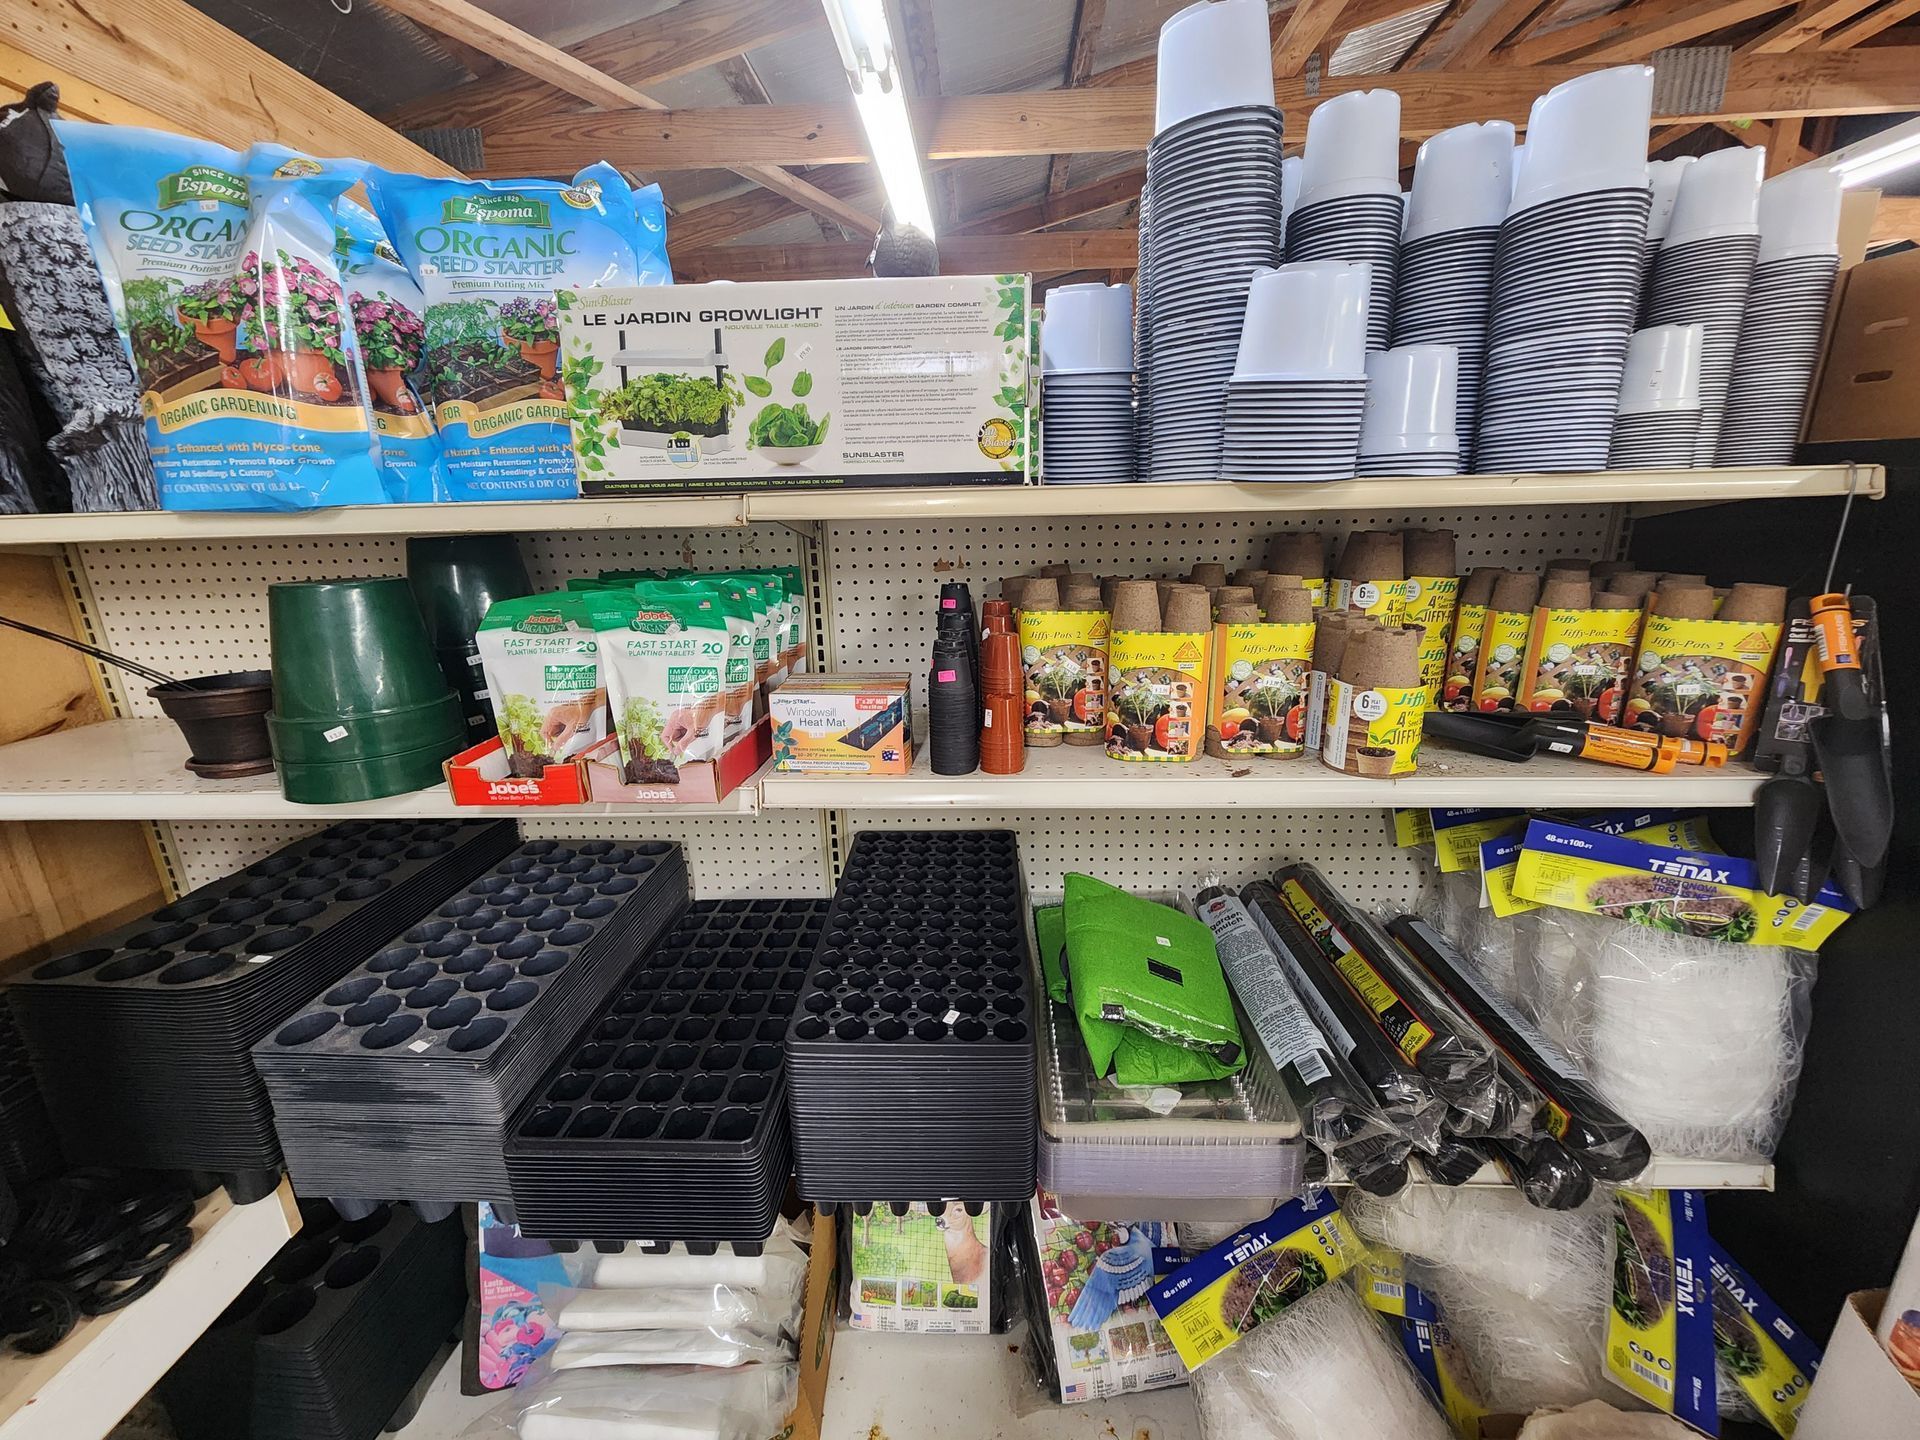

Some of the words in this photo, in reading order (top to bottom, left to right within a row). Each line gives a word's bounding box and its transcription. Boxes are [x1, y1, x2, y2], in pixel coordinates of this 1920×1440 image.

[193, 168, 225, 180] SINCE
[177, 177, 249, 200] Espom
[479, 196, 502, 205] SINCE
[463, 200, 535, 220] Espoma
[120, 210, 249, 242] ORGAN
[127, 233, 183, 254] SEED
[185, 243, 241, 260] START
[415, 227, 577, 258] ORGANIC
[142, 257, 187, 271] Premium
[190, 263, 222, 274] Potting
[430, 255, 478, 273] SEED
[484, 258, 565, 275] STARTER
[452, 280, 491, 290] Premium
[493, 280, 525, 290] Potting
[528, 281, 545, 289] Mix
[583, 314, 607, 326] LE
[614, 311, 691, 325] JARDIN
[699, 307, 823, 322] GROWLIGHT
[160, 400, 208, 426] ORGANIC
[211, 396, 297, 420] GARDENING
[443, 405, 461, 421] FOR
[473, 408, 523, 432] ORGANIC
[526, 405, 569, 420] GARDE
[176, 443, 224, 453] Enhanced
[227, 444, 250, 452] with
[450, 448, 480, 456] Natural
[489, 446, 535, 455] Enhanced
[537, 444, 560, 452] with
[842, 451, 904, 459] SUNBLASTER
[268, 457, 295, 465] Root
[298, 457, 336, 466] Growth
[460, 459, 492, 468] Moisture
[493, 458, 532, 467] Retention
[501, 468, 537, 478] Seedlings
[546, 466, 576, 476] Cutting
[174, 483, 224, 493] CONTENTS
[252, 483, 265, 493] QT
[480, 481, 527, 490] CONTENTS
[537, 480, 554, 488] DRY
[557, 479, 570, 488] QT
[1359, 587, 1366, 599] 6
[1384, 583, 1407, 596] Jiff
[1428, 596, 1443, 608] 4"
[637, 610, 674, 621] Jobe's
[1461, 610, 1484, 618] Jiffy
[1552, 615, 1580, 624] Jiffy
[1022, 617, 1042, 626] Jiffy
[1499, 617, 1525, 626] Jiffy
[1647, 621, 1672, 632] Jiffy
[1029, 631, 1073, 640] Jiffy-Pots
[1076, 631, 1081, 639] 2
[1094, 626, 1106, 636] 26
[1231, 630, 1257, 639] Jiffy
[1560, 630, 1609, 639] Jiffy-Pots
[1837, 615, 1849, 652] FISKARS
[504, 638, 533, 648] FAST
[535, 638, 573, 647] START
[627, 641, 657, 649] FAST
[660, 640, 698, 649] START
[731, 634, 752, 646] 20
[1650, 637, 1711, 650] Jiffy-Pots
[1716, 641, 1724, 649] 2
[1746, 638, 1764, 650] 26
[576, 640, 598, 653] 20
[702, 642, 723, 655] 20
[1240, 644, 1289, 654] Jiffy-Pots
[1293, 644, 1299, 652] 2
[1112, 651, 1156, 661] Jiffy-Pots
[1181, 649, 1196, 659] 26
[1421, 663, 1436, 677] 4"
[546, 680, 596, 690] GUARANTEED
[1362, 694, 1370, 709] 6
[1394, 691, 1425, 707] Jiff
[786, 706, 837, 717] Windowsill
[799, 718, 823, 727] Heat
[826, 717, 846, 727] Mat
[1397, 711, 1414, 728] 4"
[1389, 728, 1421, 745] JIFFY-
[488, 779, 541, 794] Jobe's
[636, 787, 676, 799] Jobe's
[1569, 838, 1593, 850] 100-FT
[1649, 858, 1730, 884] TENAX
[1652, 874, 1718, 894] HORTONOVA
[1210, 911, 1243, 930] garden
[1214, 917, 1243, 935] mulch
[1224, 1232, 1272, 1267] TENAX
[484, 1279, 503, 1287] Lasts
[1676, 1257, 1694, 1316] TENAX
